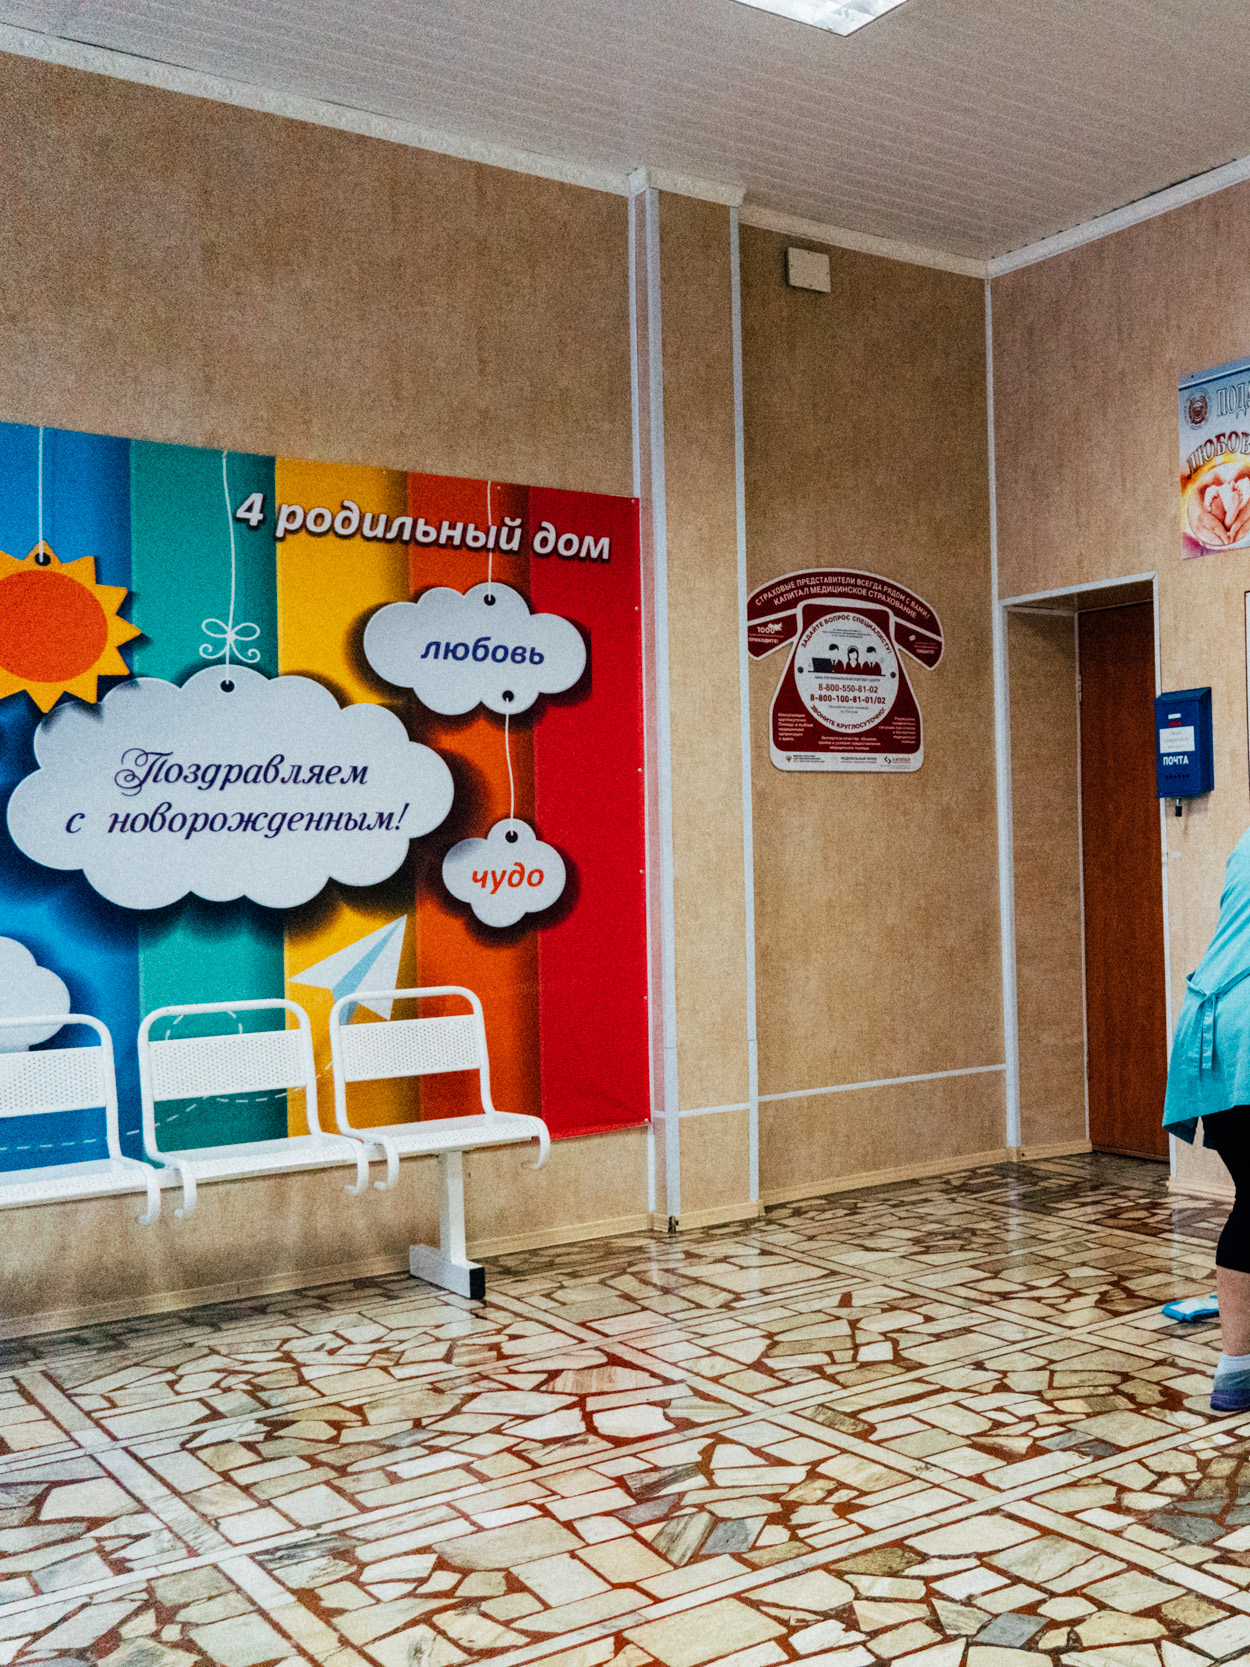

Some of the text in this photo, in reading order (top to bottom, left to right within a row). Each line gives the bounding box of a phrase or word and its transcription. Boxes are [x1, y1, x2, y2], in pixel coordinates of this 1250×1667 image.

[236, 492, 611, 560] 4 родильный дом
[755, 582, 796, 606] СТРАХОВЫЕ
[796, 576, 856, 587] ПРЕДСТАВИТЕЛИ
[857, 578, 882, 591] ВСЕГДА
[883, 585, 906, 600] РЯДОМ
[910, 600, 931, 619] ВАМИ!
[773, 585, 917, 619] КАПИТАЛ МЕДИЦИНСКОЕ СТРАХОВАНИЕ
[757, 626, 776, 634] 1000
[801, 614, 892, 654] ЗАДАЙТЕ ВОПРОС СПЕЦИАЛИСТУ!
[420, 636, 545, 665] любовь
[810, 694, 886, 705] 8-800-100-81-01/02
[818, 683, 878, 693] 8-800-550-81-02
[811, 705, 835, 726] ЗВОНИТЕ
[836, 706, 886, 729] КРУГЛОСУТОЧНО!
[114, 748, 369, 796] Поздравляем
[1162, 755, 1189, 765] ПОЧТА
[65, 801, 410, 839] с новорожденным!
[471, 862, 545, 892] чудо
